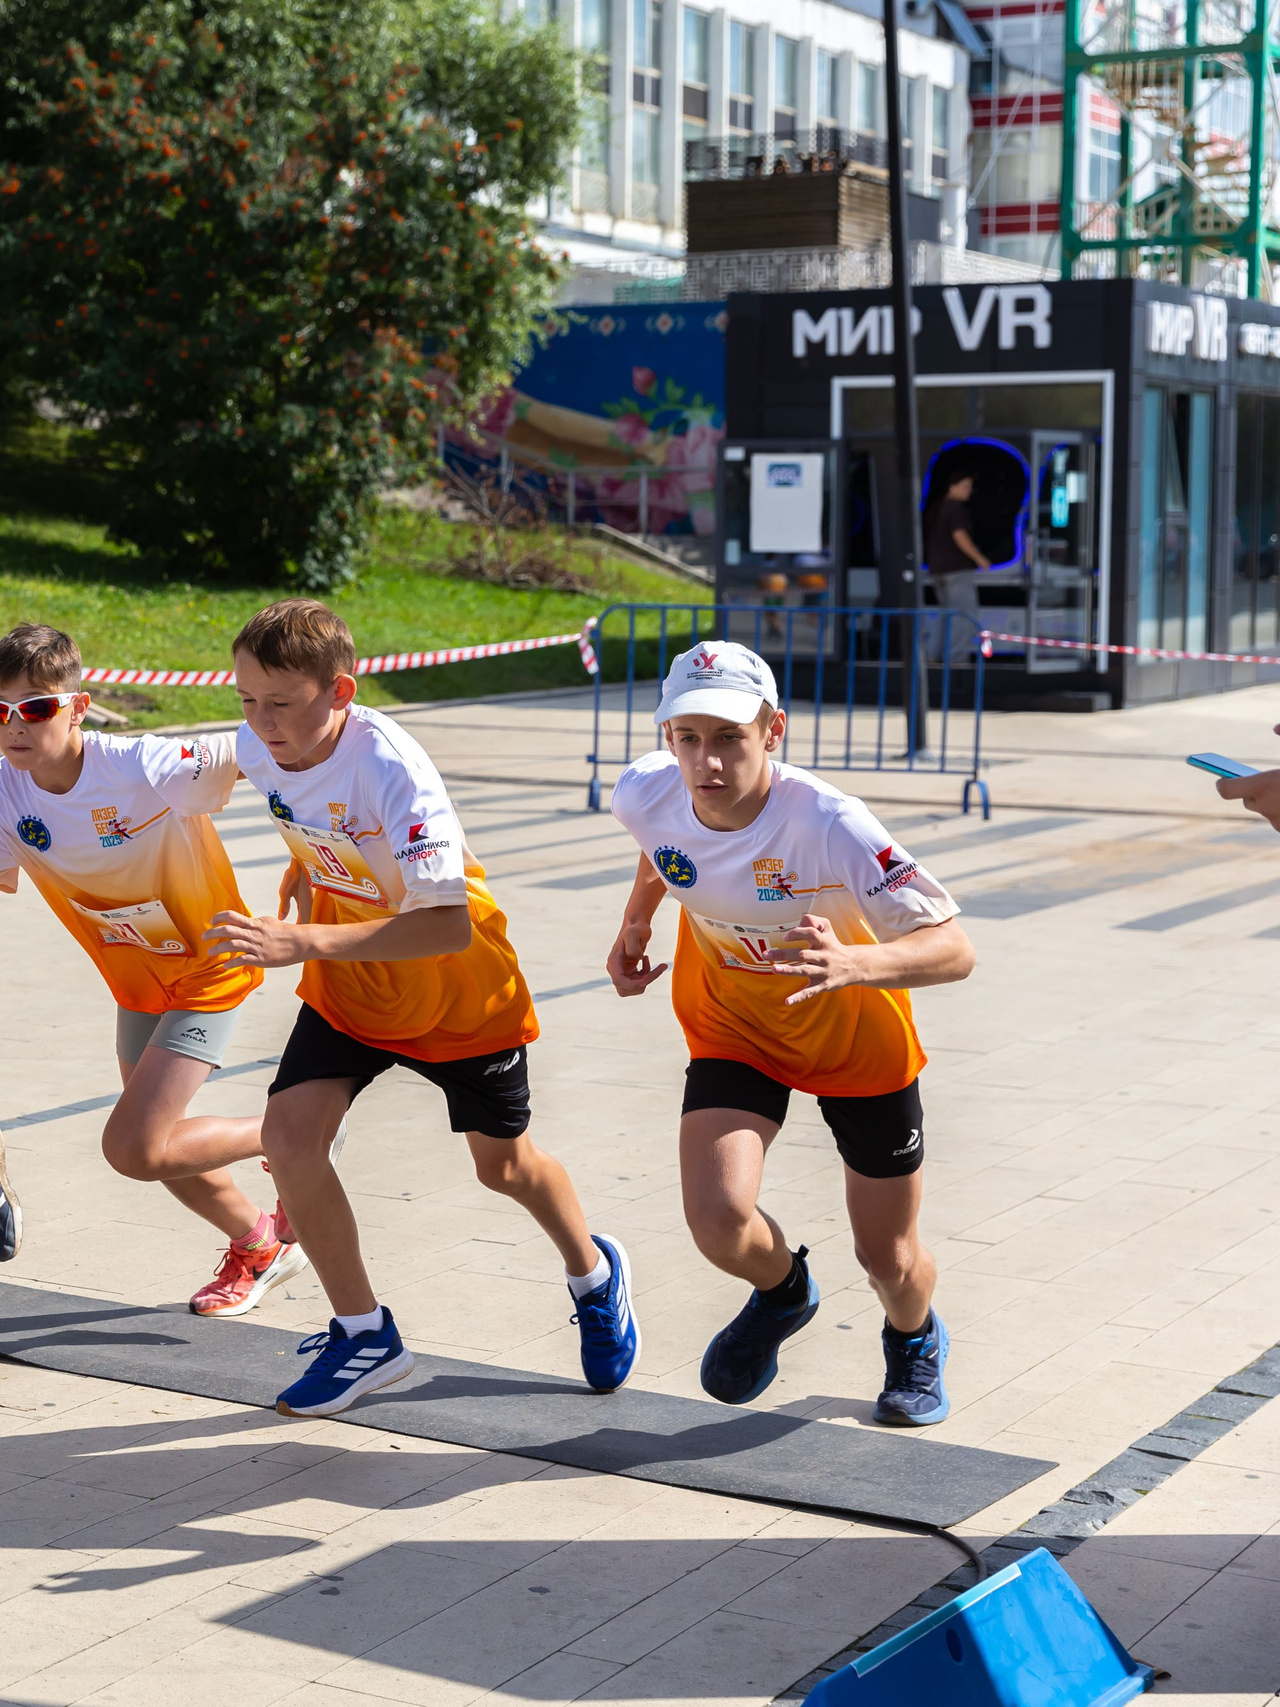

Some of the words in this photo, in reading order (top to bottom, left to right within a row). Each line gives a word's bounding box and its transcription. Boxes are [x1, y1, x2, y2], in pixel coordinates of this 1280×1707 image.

[942, 284, 1053, 351] VR
[1191, 294, 1228, 361] VR
[91, 806, 118, 822] ЛАЗЕР
[99, 834, 123, 848] 2025
[307, 841, 349, 878] 79
[407, 849, 438, 863] СПОРТ
[753, 858, 783, 872] ЛАЗЕР
[888, 870, 918, 893] СПОРТ
[757, 888, 784, 901] 2025
[180, 1032, 207, 1044] ATHLEX
[483, 1050, 520, 1075] FILA
